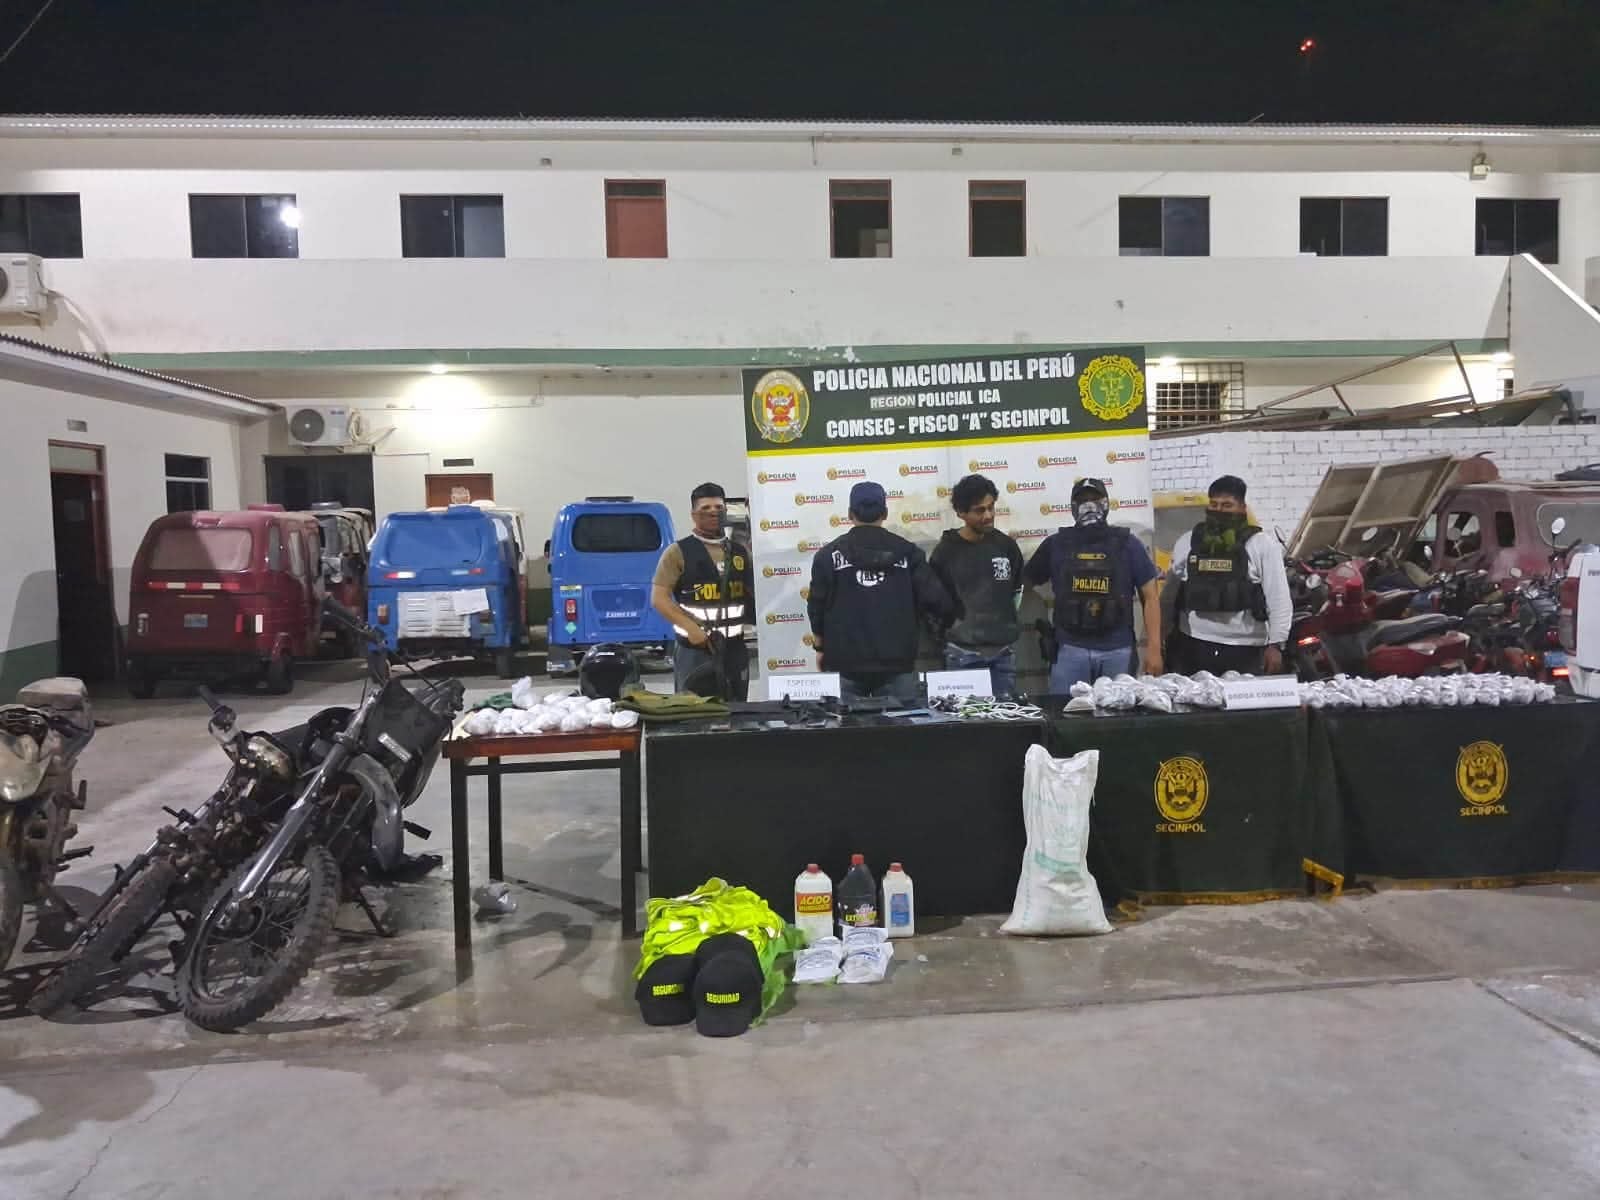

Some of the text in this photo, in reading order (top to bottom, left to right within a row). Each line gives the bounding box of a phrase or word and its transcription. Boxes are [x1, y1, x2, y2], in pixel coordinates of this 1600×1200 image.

[813, 367, 889, 392] POLICIA
[892, 361, 986, 388] NACIONAL
[989, 359, 1023, 382] DEL
[1026, 352, 1075, 380] PERÚ
[870, 388, 1001, 409] REGION POLICIAL ICA
[826, 417, 895, 439] COMSEC
[908, 413, 959, 434] PISCO
[991, 407, 1071, 429] SECINPOL
[1074, 578, 1106, 591] POLICIA
[1460, 805, 1509, 817] SECINPOL
[1155, 823, 1207, 833] SECINPOL
[800, 895, 831, 905] ACIDO
[706, 992, 740, 1004] SEGURIDAD
